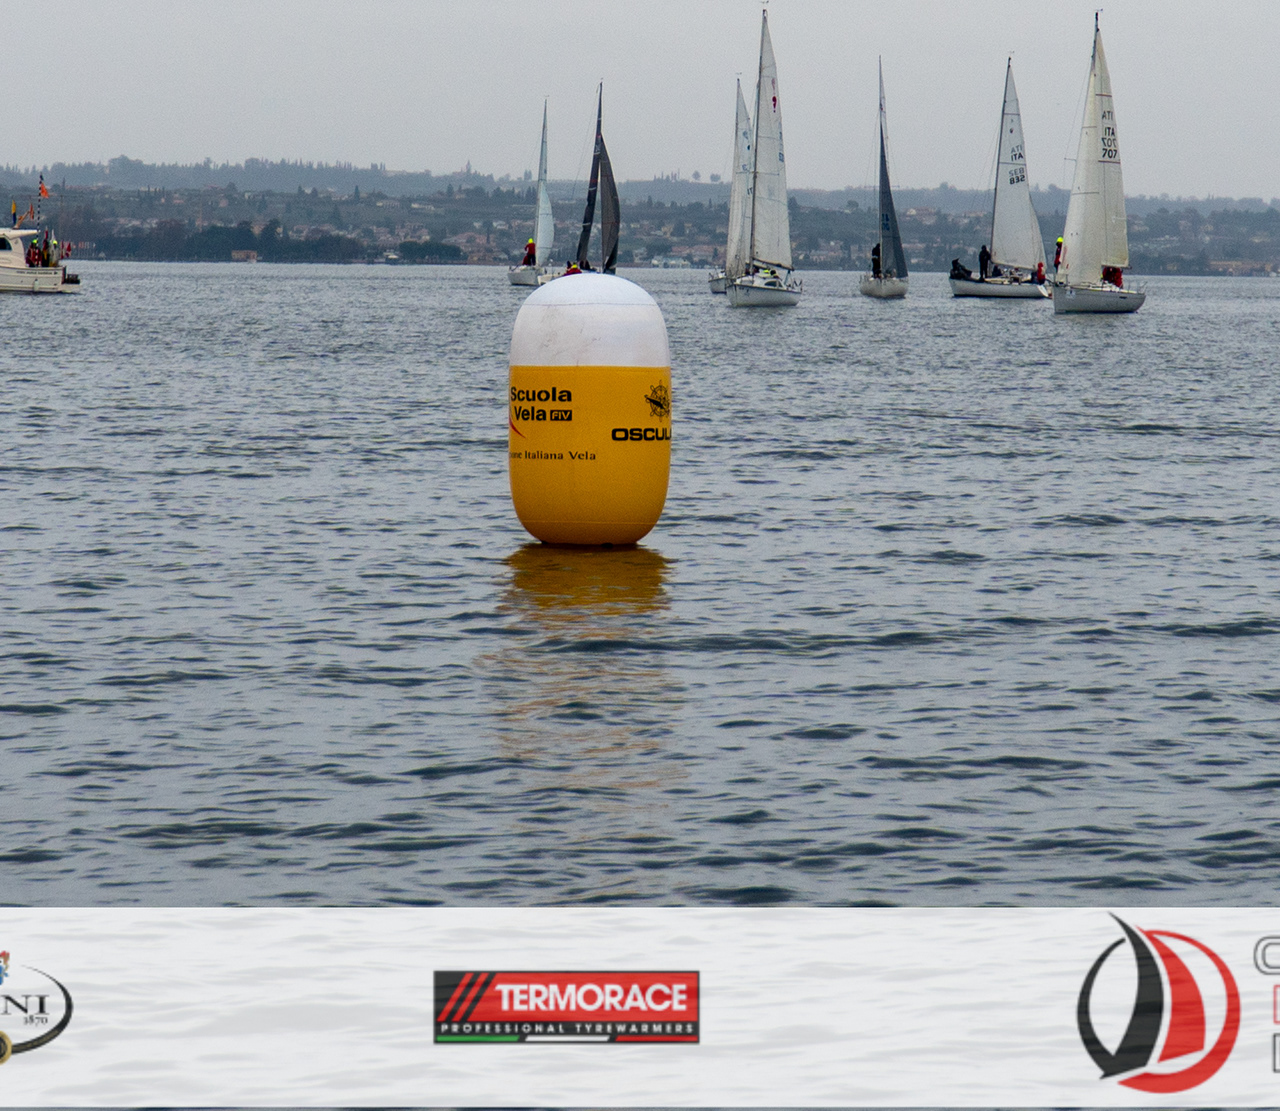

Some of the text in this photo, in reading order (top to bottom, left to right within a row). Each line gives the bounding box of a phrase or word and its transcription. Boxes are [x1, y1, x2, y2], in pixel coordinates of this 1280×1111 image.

[1105, 127, 1115, 137] ITA
[1011, 153, 1024, 161] ITA
[1102, 148, 1117, 158] 707
[1009, 174, 1026, 185] 832
[510, 386, 572, 402] Scuola
[514, 406, 571, 421] Vela FIV
[525, 451, 564, 460] Italiana
[568, 451, 596, 460] Vela
